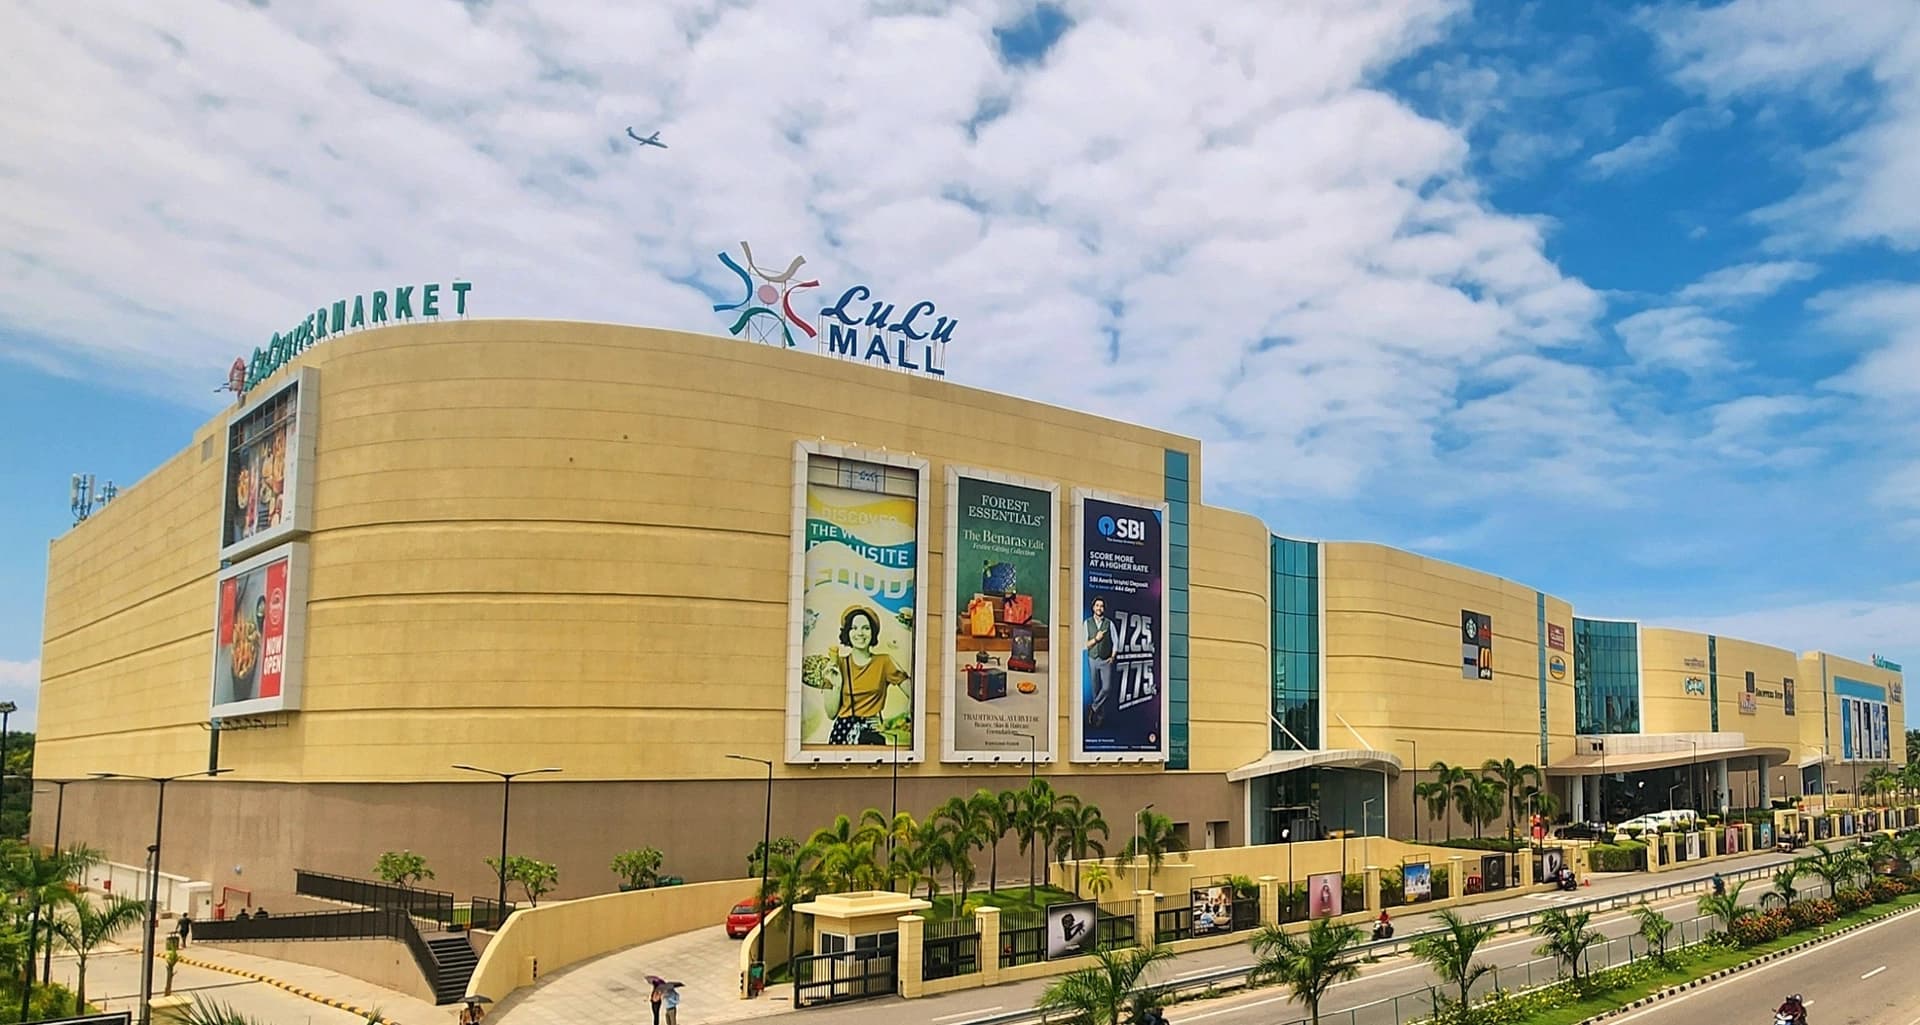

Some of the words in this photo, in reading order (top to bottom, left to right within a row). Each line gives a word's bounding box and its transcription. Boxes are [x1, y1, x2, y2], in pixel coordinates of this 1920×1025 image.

[281, 282, 472, 365] HYPERMARKET
[820, 285, 959, 344] LuLu
[829, 323, 945, 376] MALL
[982, 495, 1029, 513] FOREST
[810, 523, 837, 538] THE
[963, 528, 981, 541] The
[983, 530, 1027, 547] Benaras
[1028, 538, 1045, 551] Edit
[1116, 518, 1145, 541] SBI
[810, 540, 909, 566] ISITE
[1089, 551, 1114, 561] SCORE
[1114, 554, 1135, 564] MORE
[1089, 559, 1099, 568] AT
[1099, 560, 1105, 569] A
[1105, 561, 1132, 571] HIGHER
[1132, 563, 1149, 573] RATE
[263, 654, 282, 676] OPEN
[963, 713, 1006, 722] TRADITIONAL
